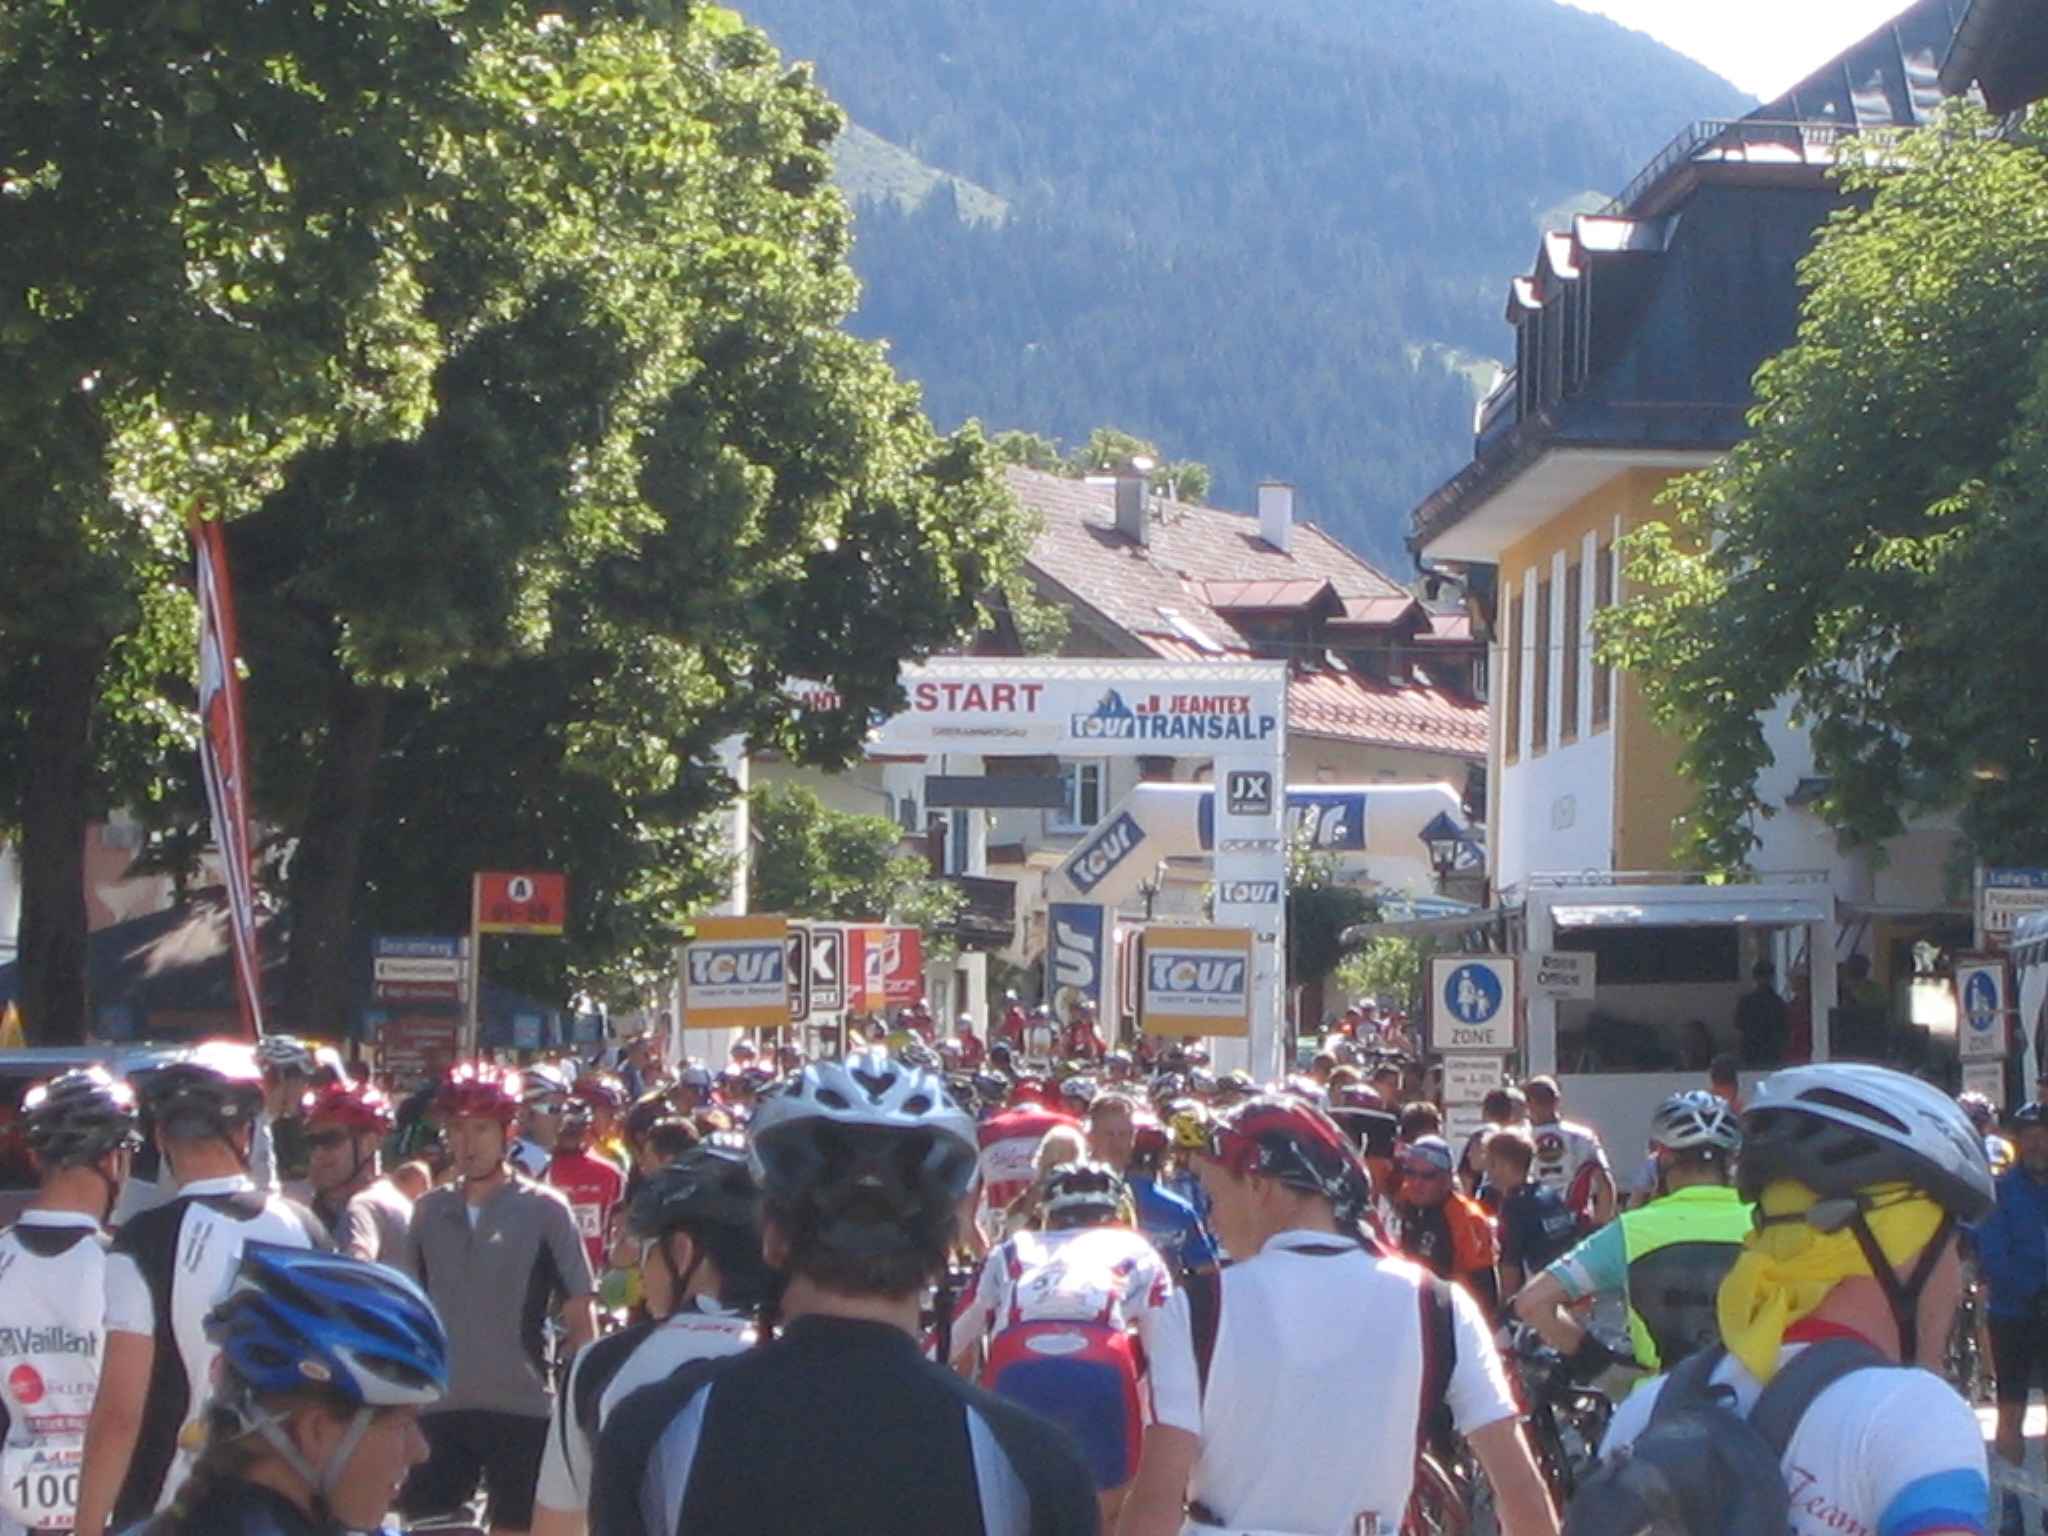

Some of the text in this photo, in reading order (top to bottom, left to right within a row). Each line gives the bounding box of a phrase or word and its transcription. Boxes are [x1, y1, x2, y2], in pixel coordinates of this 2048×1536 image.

[914, 683, 1043, 712] START
[1169, 695, 1250, 714] JEANTEX
[1135, 715, 1276, 739] TRANSALP
[1232, 776, 1266, 799] JX
[1451, 1028, 1496, 1045] ZONE
[15, 1326, 96, 1357] Vaillant
